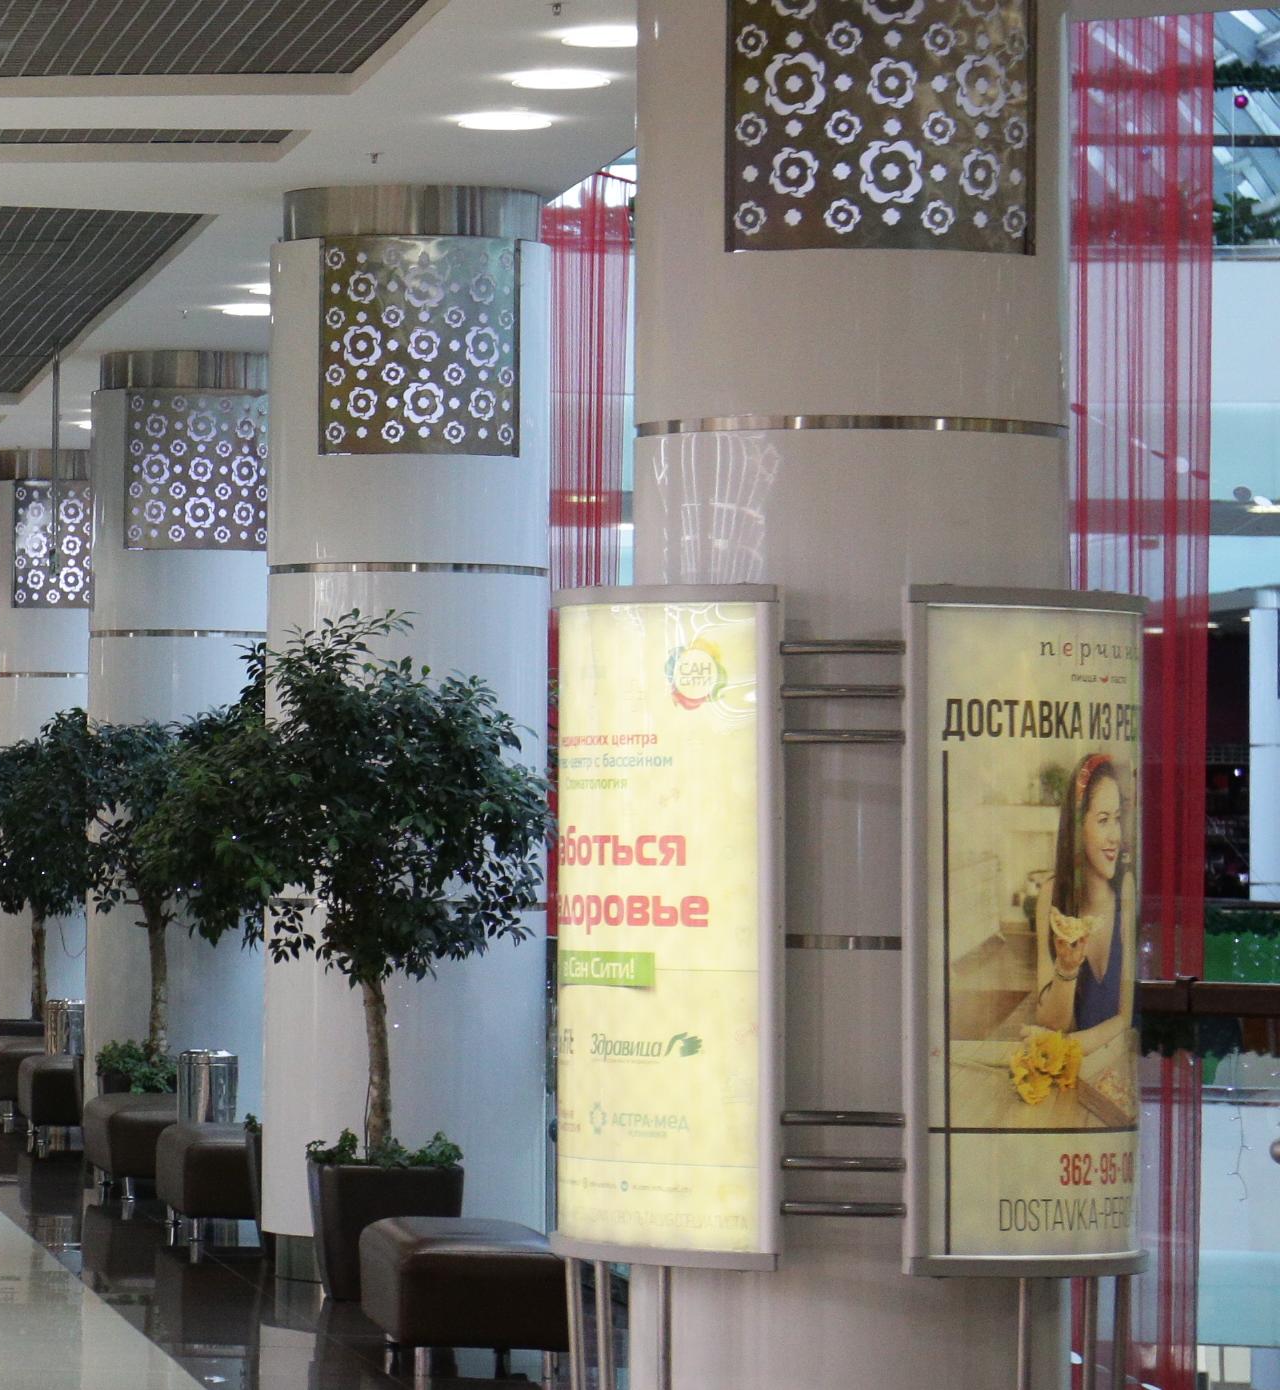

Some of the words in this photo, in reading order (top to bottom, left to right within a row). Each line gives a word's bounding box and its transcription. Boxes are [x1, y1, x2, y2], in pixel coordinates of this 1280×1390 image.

[679, 662, 712, 676] САН
[942, 698, 1083, 741] ДОСТАВКА
[1088, 702, 1111, 740] ИЗ
[611, 734, 658, 748] центра
[603, 753, 673, 768] бассейном
[569, 957, 589, 977] Сан
[590, 957, 636, 980] Сити!
[590, 1032, 663, 1062] Здравица
